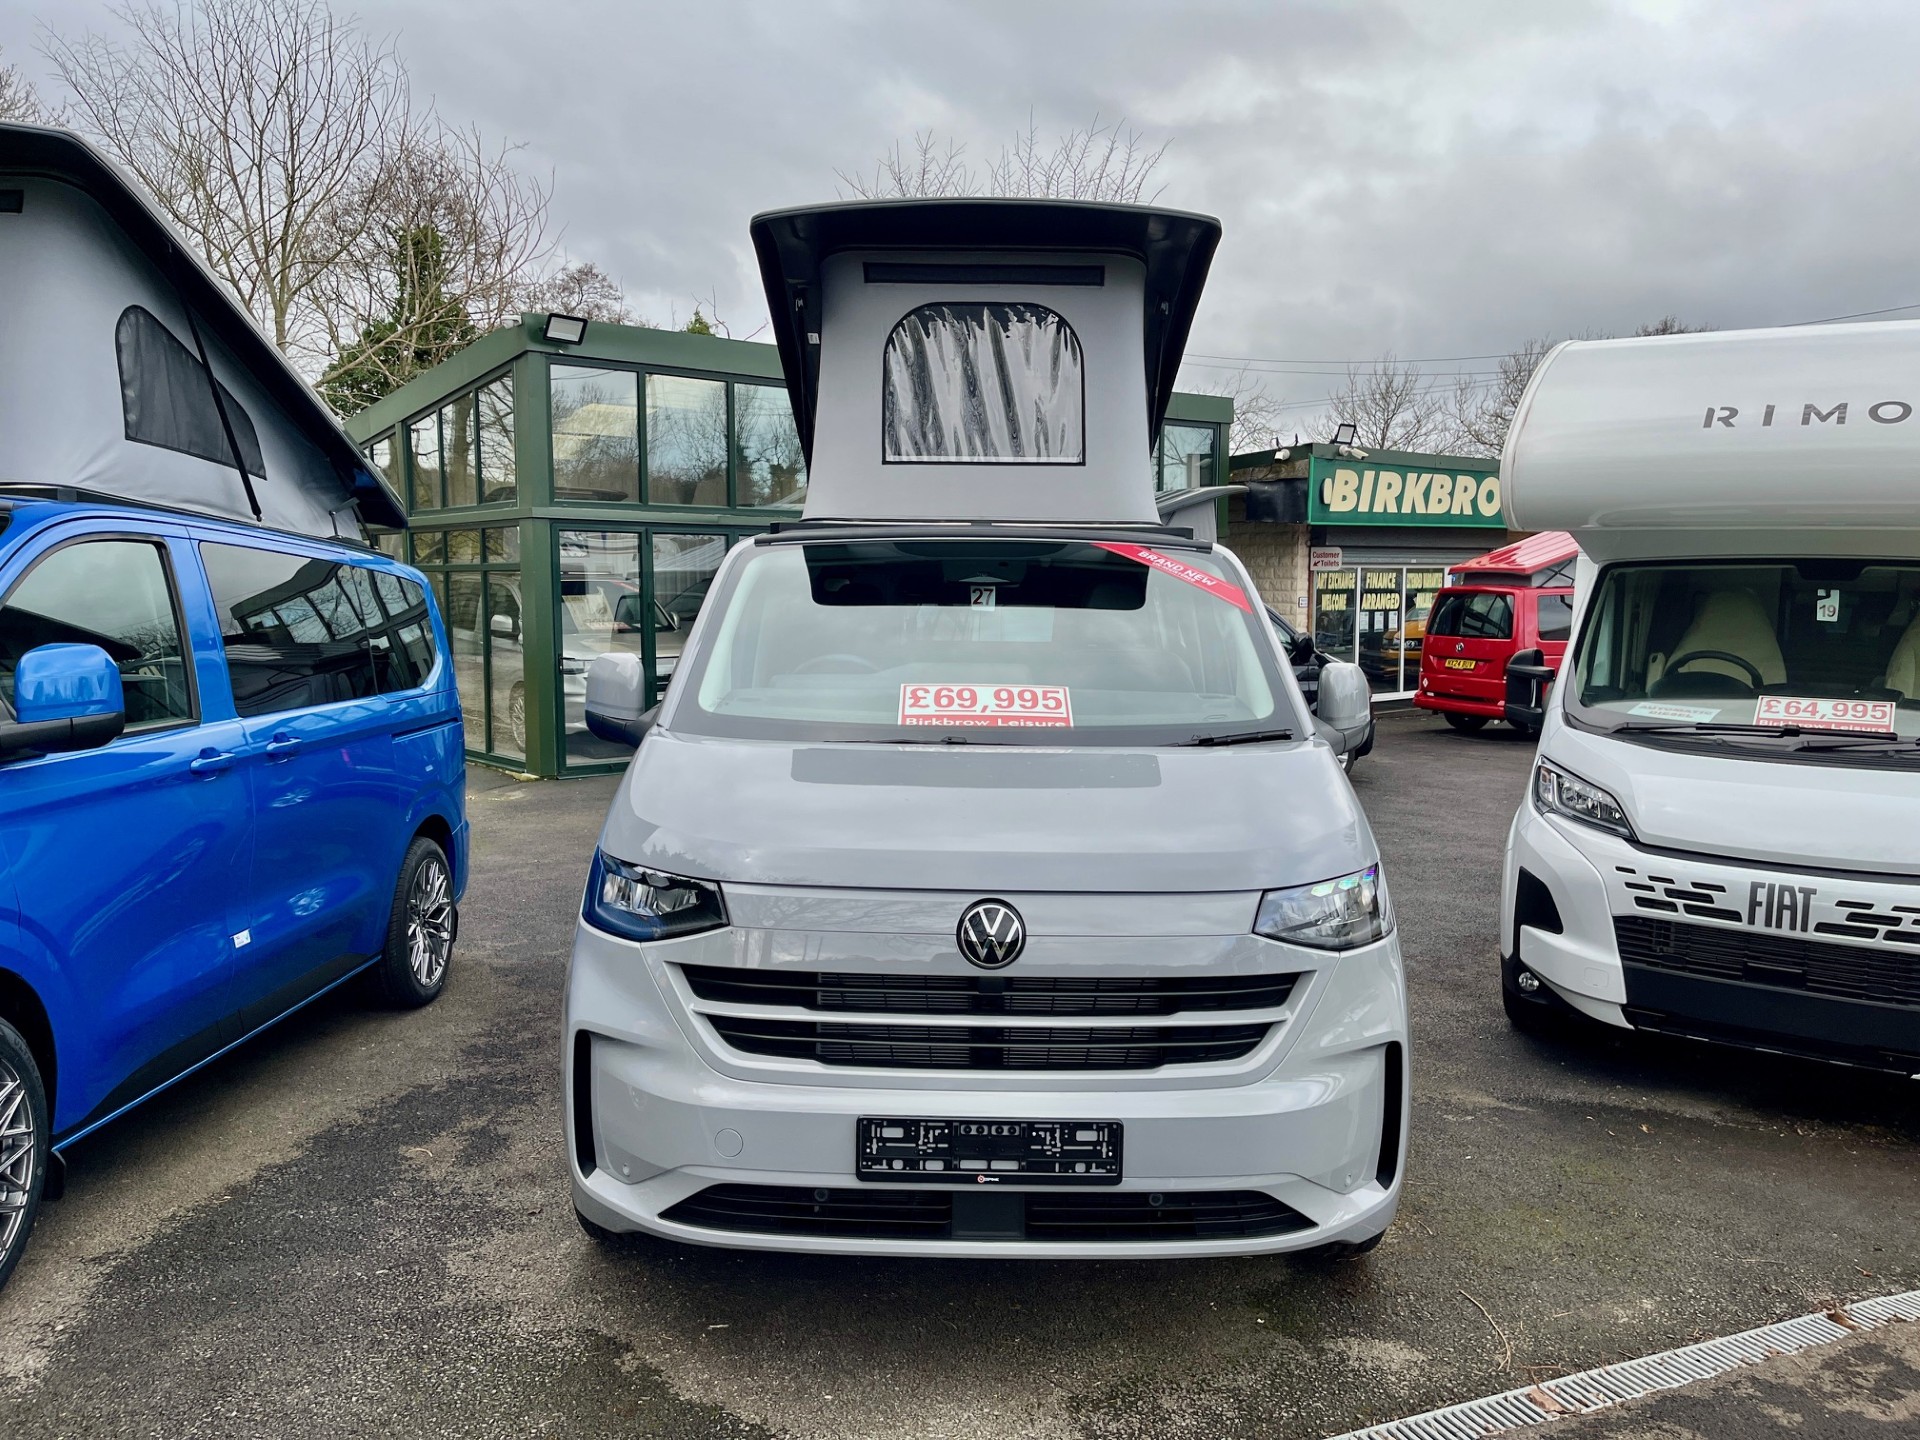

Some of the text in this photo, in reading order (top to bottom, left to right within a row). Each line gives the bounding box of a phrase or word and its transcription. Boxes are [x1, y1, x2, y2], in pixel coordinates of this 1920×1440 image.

[1702, 401, 1912, 428] RIMO
[1329, 469, 1500, 517] BIRKBRO
[1312, 551, 1340, 559] Customer
[1137, 551, 1217, 586] BRAND NEW
[1365, 572, 1397, 589] FINANCE
[972, 588, 993, 605] 27
[1321, 593, 1347, 611] WELCOME
[1361, 592, 1400, 610] ARRANGED
[1819, 604, 1836, 617] 19
[908, 687, 1064, 714] £69,995
[1762, 699, 1889, 721] £64,995
[905, 717, 1066, 728] Birkbrow Leisure
[1747, 881, 1817, 932] FIAT
